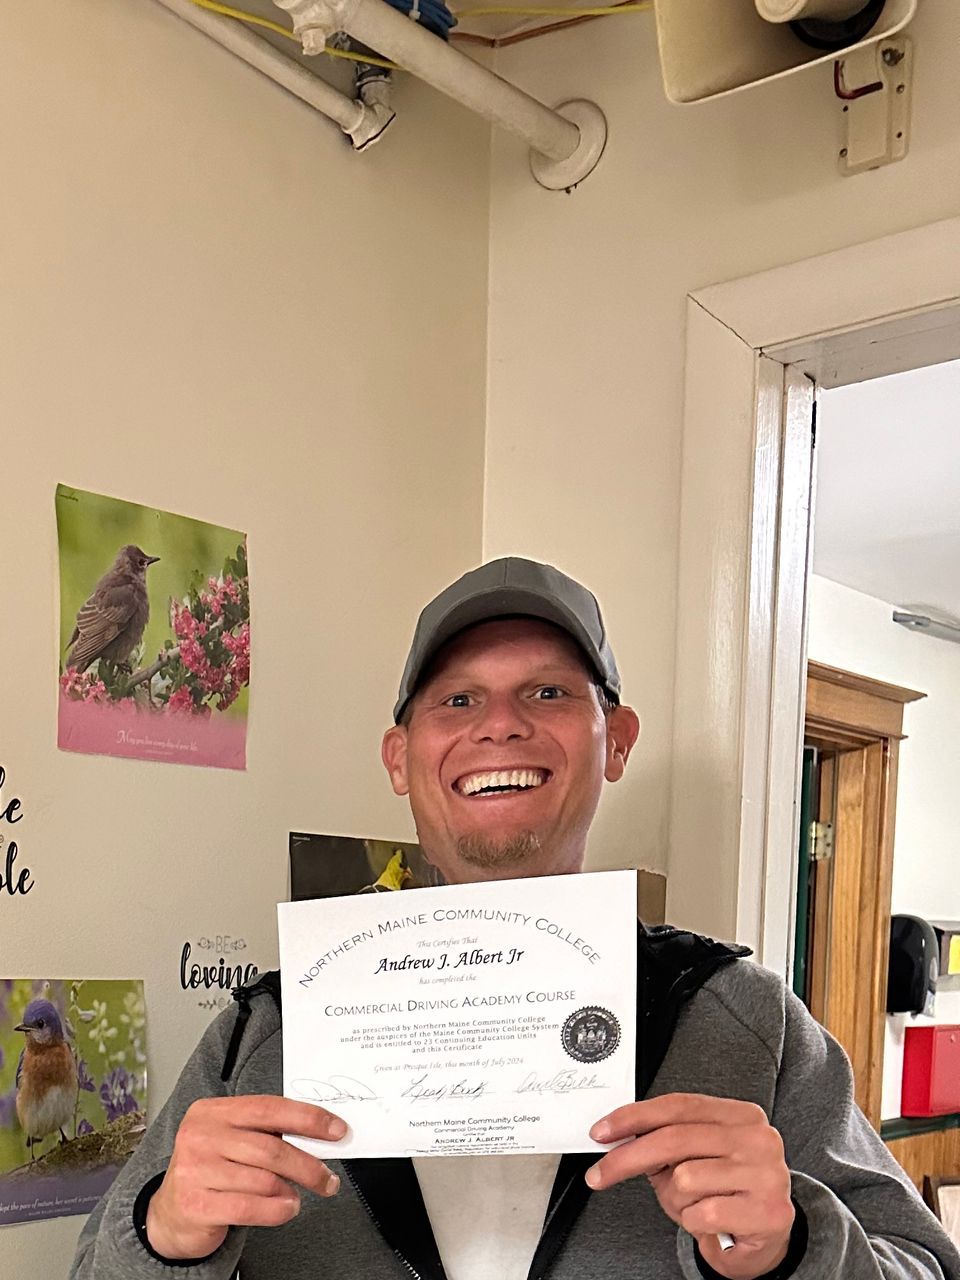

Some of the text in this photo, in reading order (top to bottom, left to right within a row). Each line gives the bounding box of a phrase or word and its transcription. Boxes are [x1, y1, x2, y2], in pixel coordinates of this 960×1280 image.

[216, 936, 232, 954] BE
[299, 909, 601, 988] NORTHERN MAINE COMMUNITY COLLEGE
[374, 949, 525, 975] Andrew J. Albert Jr
[324, 990, 576, 1017] COMMERCIAL DRIVING ACADEMY COURSE
[340, 1035, 361, 1043] under
[376, 1032, 408, 1042] auspices
[420, 1030, 431, 1038] the
[456, 1026, 499, 1036] Community
[502, 1024, 530, 1034] College
[532, 1022, 560, 1032] System
[362, 1025, 400, 1035] prescribed
[402, 1024, 410, 1033] by
[414, 1022, 446, 1030] Northern
[448, 1020, 470, 1028] Maine
[472, 1017, 516, 1027] Community
[518, 1015, 546, 1024] College
[384, 1040, 412, 1048] entitled
[434, 1036, 476, 1045] Continuing
[478, 1034, 514, 1042] Education
[518, 1032, 537, 1040] Units
[412, 1042, 482, 1054] and this Certificate
[409, 1120, 442, 1128] Northern
[468, 1117, 511, 1125] Community
[514, 1114, 540, 1122] College
